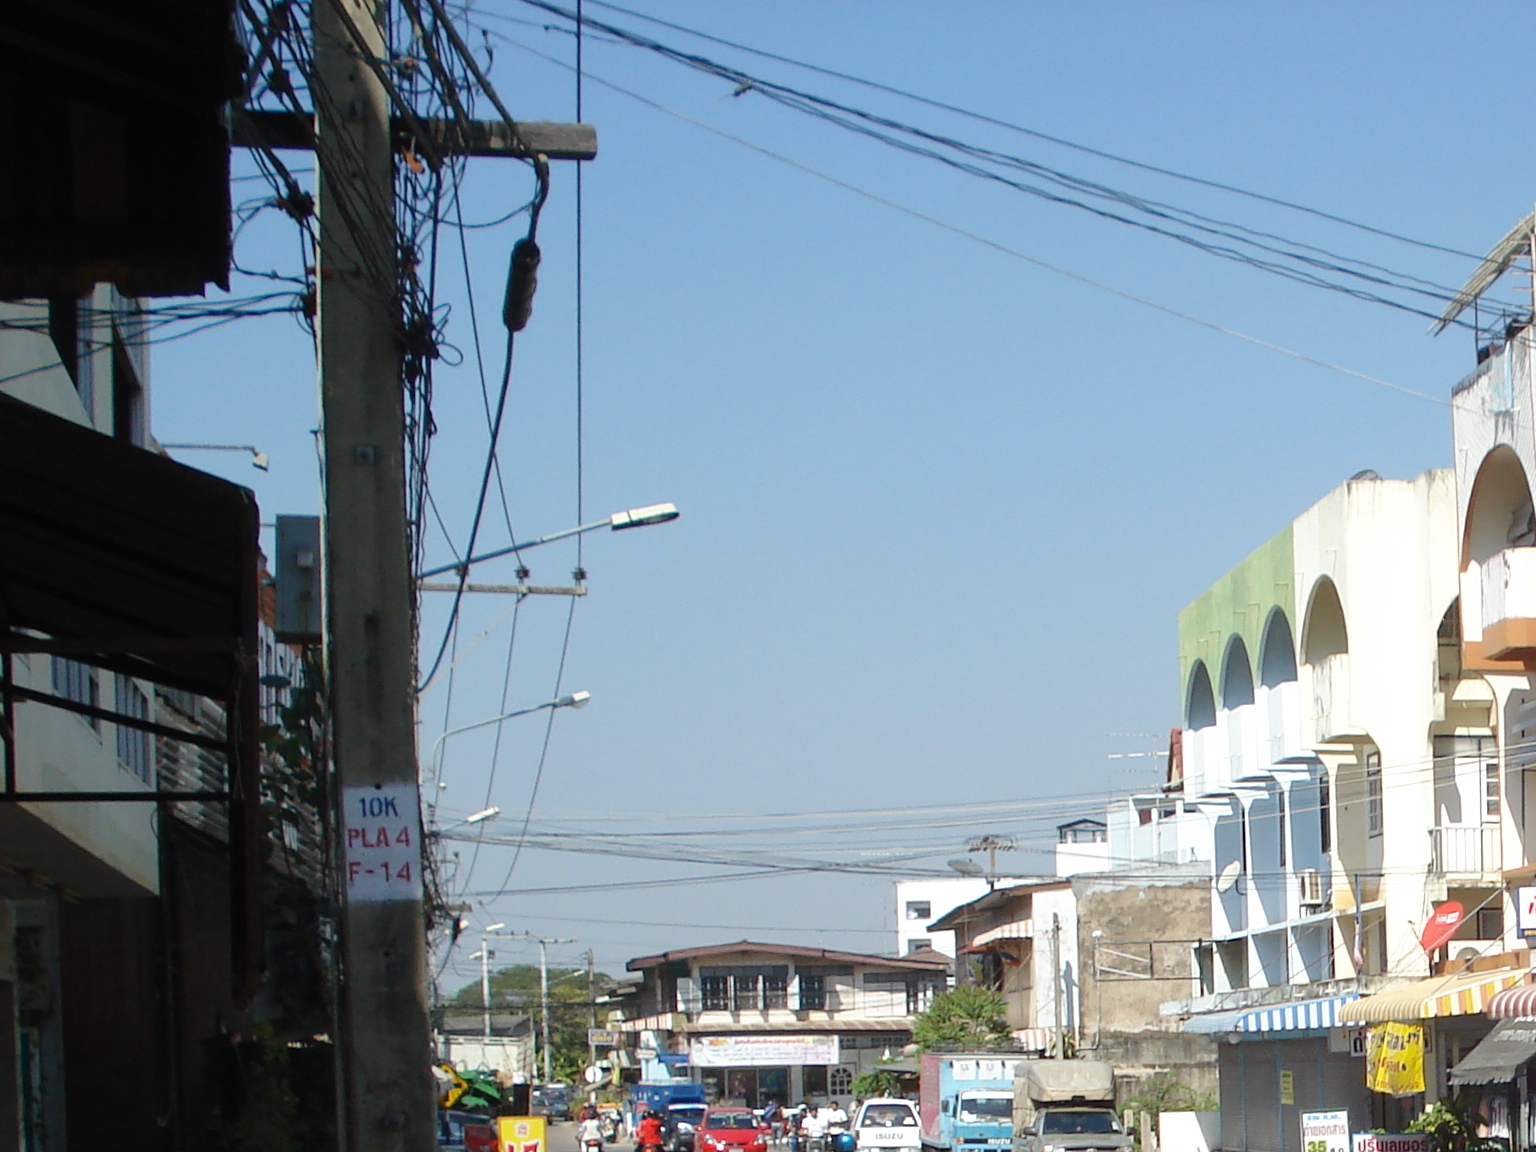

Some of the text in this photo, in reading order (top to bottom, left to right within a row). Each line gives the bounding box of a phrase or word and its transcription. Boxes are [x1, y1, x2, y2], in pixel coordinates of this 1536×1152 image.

[358, 796, 399, 818] 10K
[347, 826, 410, 848] PLA 4
